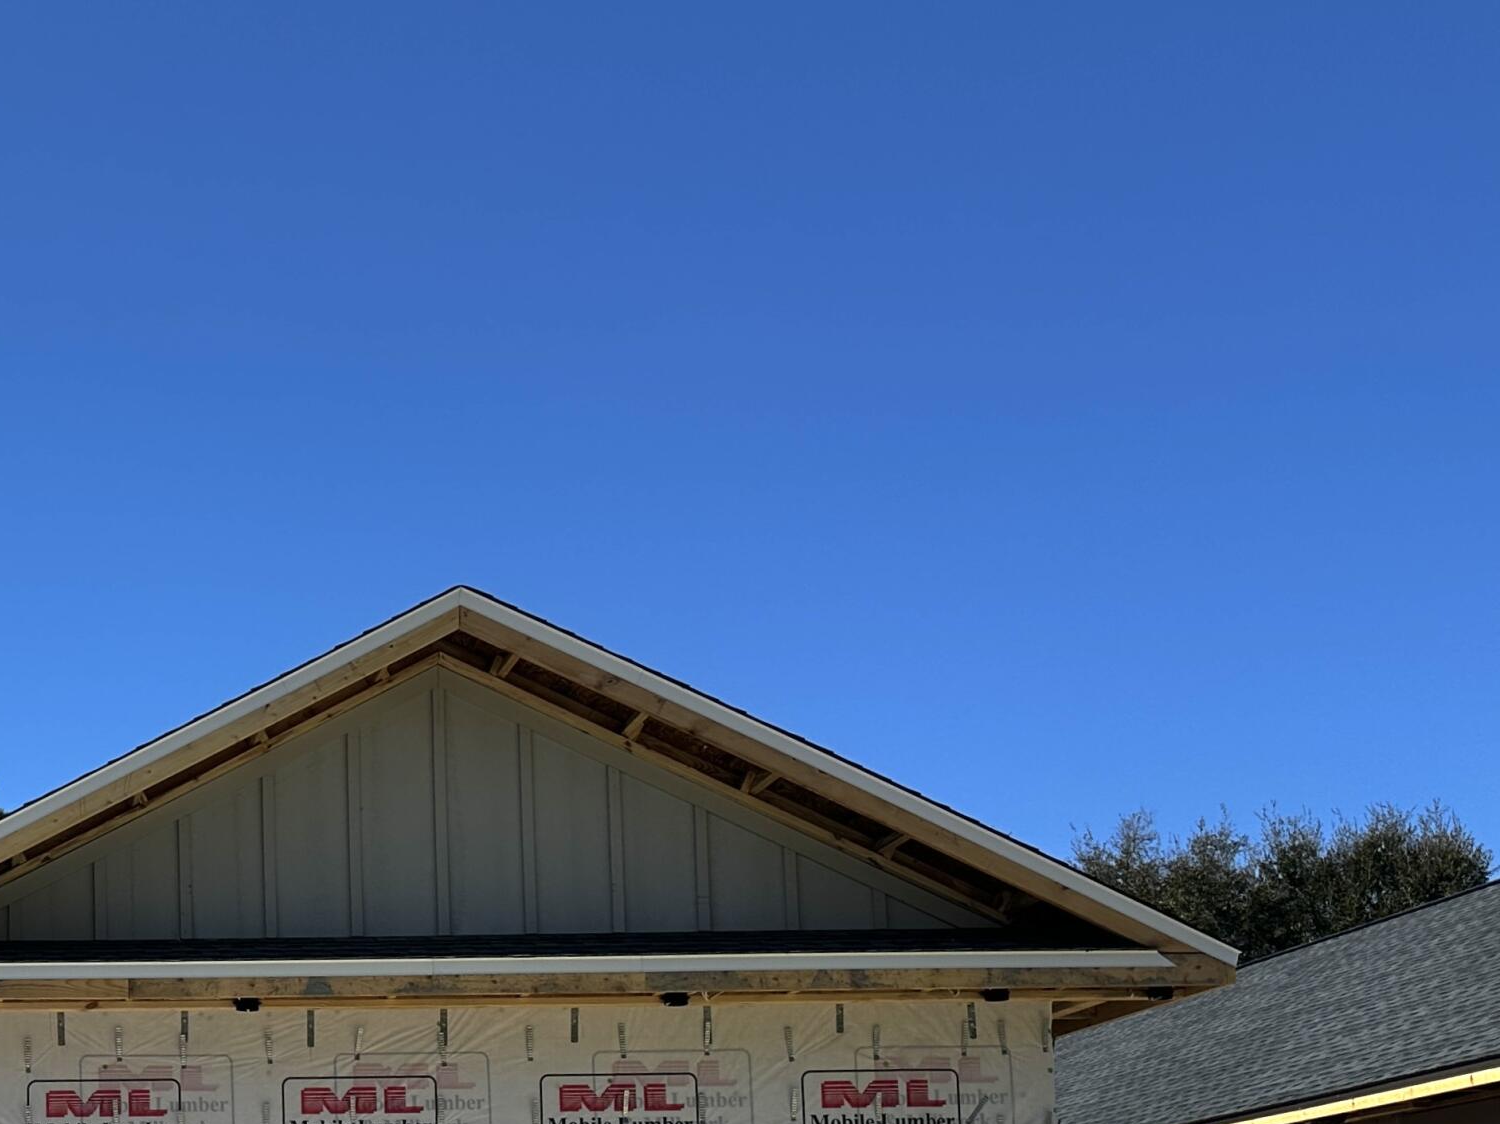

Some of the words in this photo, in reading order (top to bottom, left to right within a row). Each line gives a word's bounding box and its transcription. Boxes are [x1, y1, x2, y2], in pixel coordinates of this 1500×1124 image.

[46, 1089, 168, 1118] ML
[301, 1086, 424, 1115] ML
[559, 1083, 685, 1113] ML
[820, 1079, 946, 1109] ML
